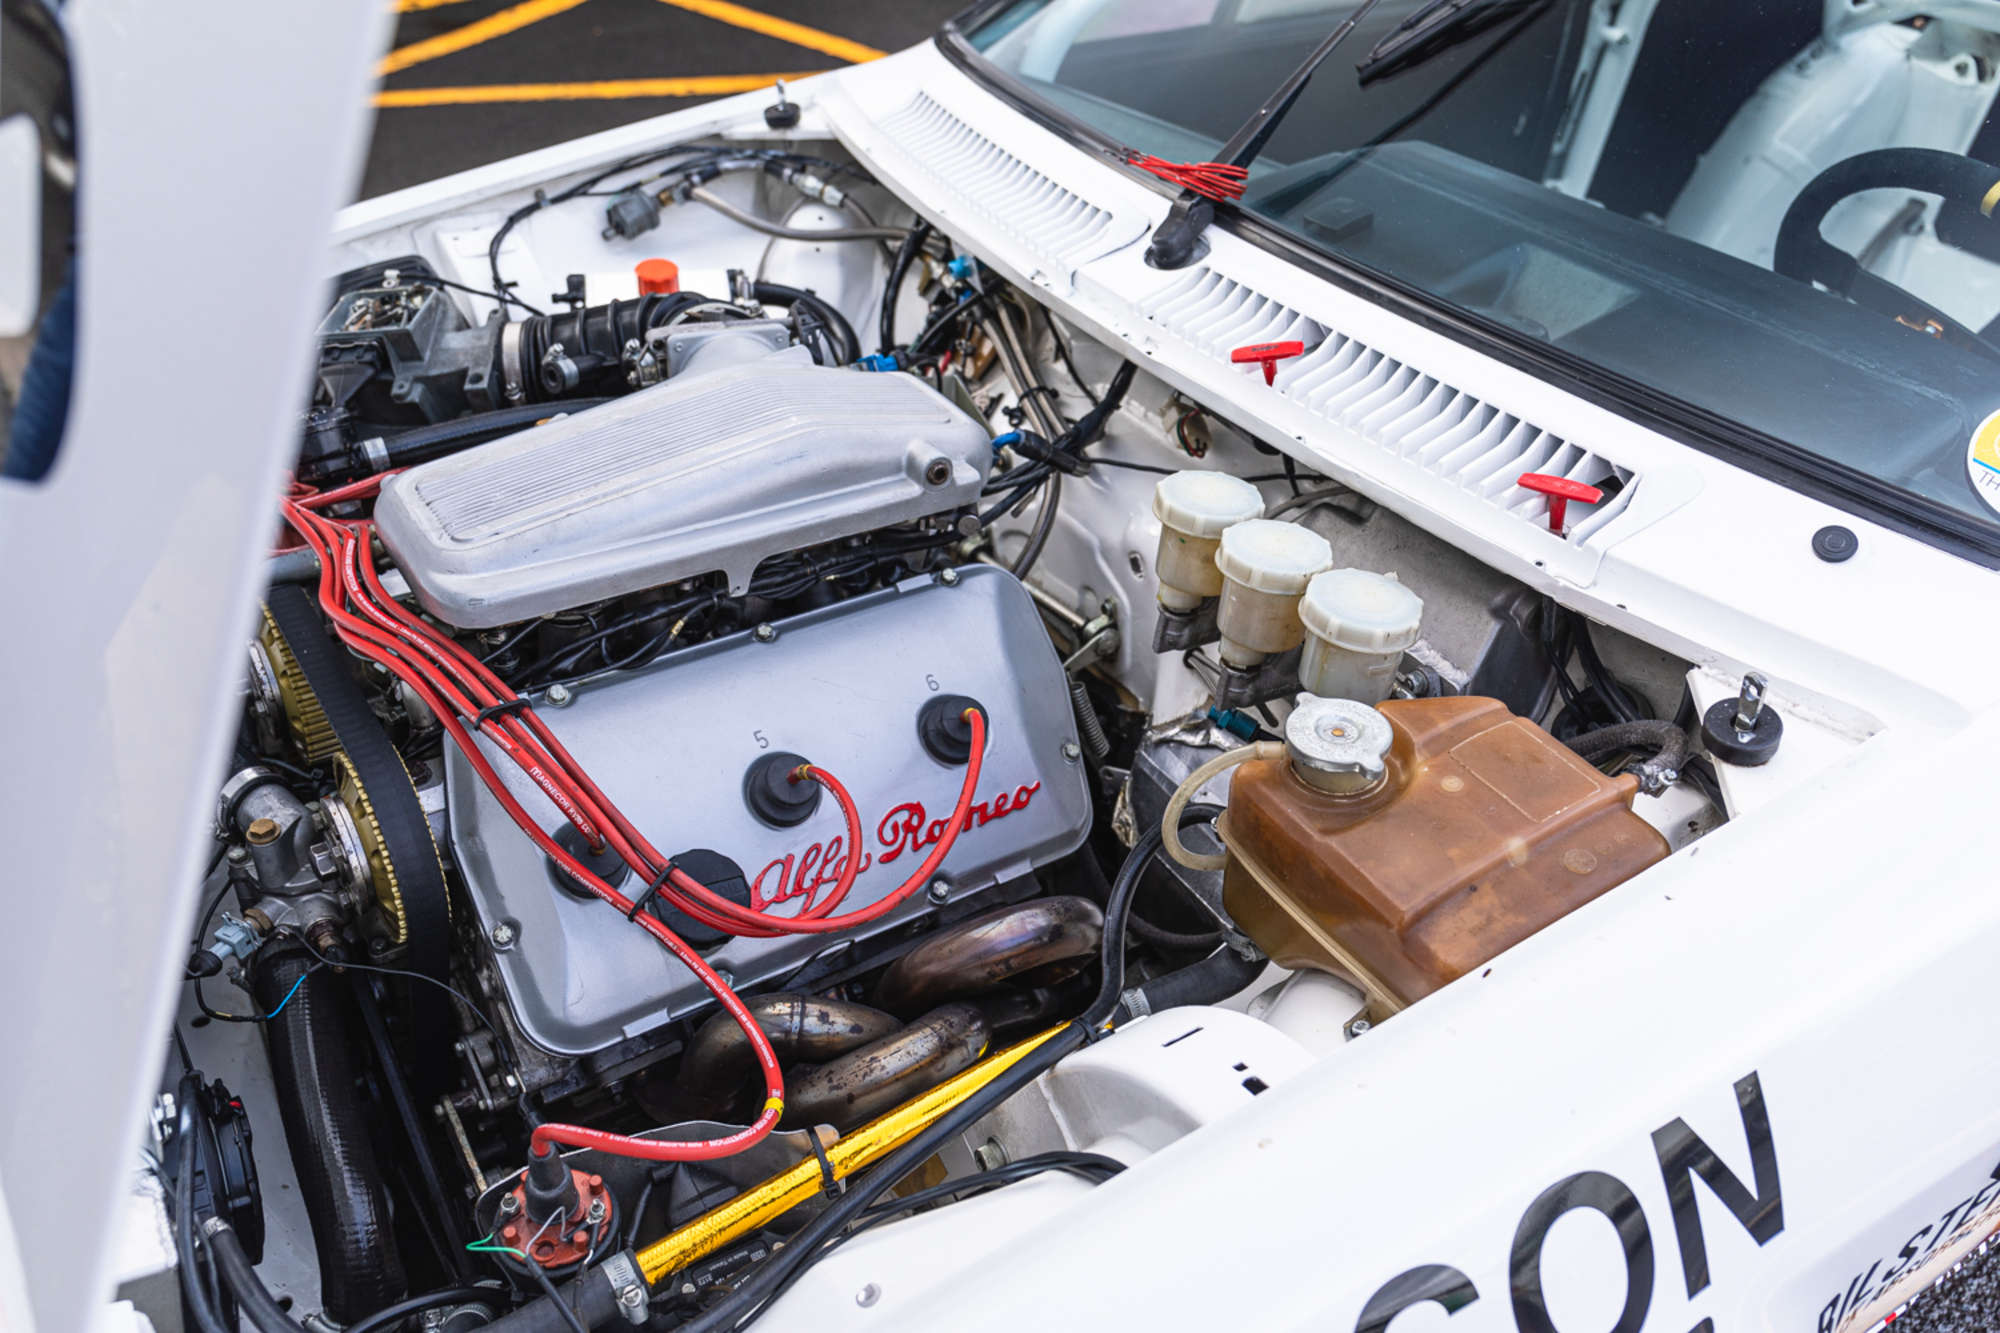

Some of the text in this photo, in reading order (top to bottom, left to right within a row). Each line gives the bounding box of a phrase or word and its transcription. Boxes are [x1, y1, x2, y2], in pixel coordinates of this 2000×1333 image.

[925, 674, 940, 692] 6
[753, 729, 769, 749] 5
[530, 766, 570, 808] MAGNECOR
[878, 781, 1041, 864] Romeo
[571, 871, 613, 903] COMPETITION
